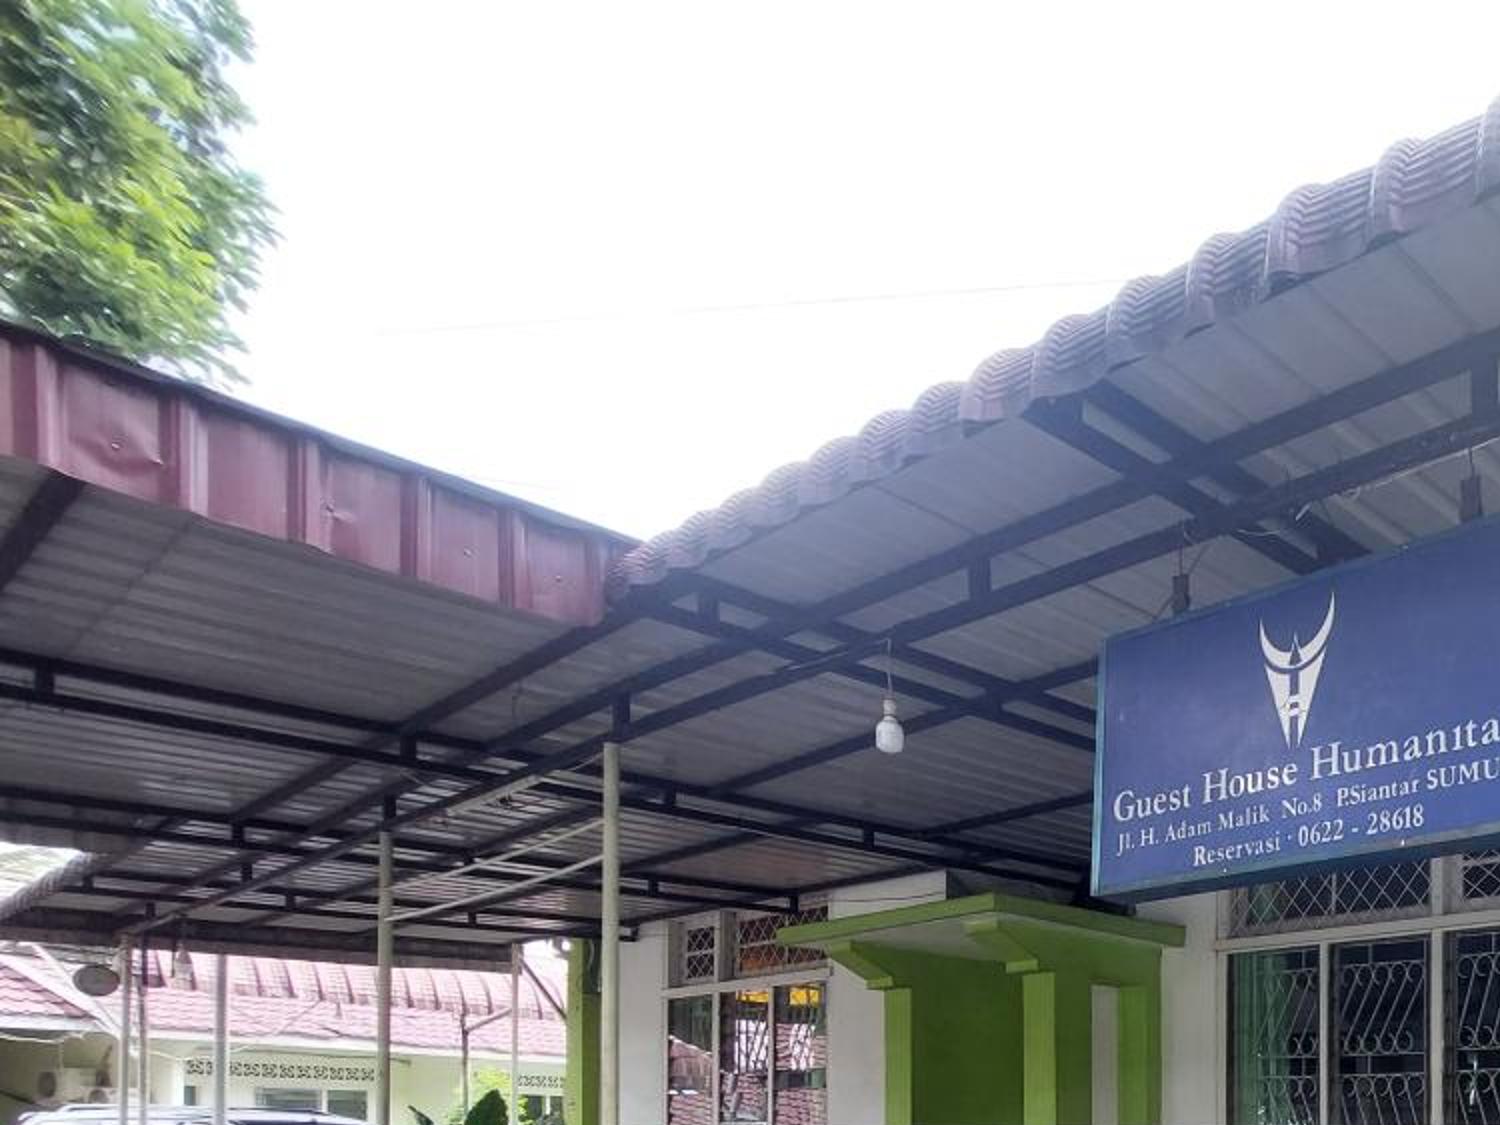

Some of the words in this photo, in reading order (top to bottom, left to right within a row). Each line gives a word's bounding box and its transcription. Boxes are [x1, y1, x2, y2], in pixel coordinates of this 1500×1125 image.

[1113, 784, 1190, 822] Guest
[1202, 762, 1298, 805] House
[1140, 826, 1160, 847] H.
[1165, 820, 1212, 842] Adam
[1218, 804, 1270, 831] Malik
[1281, 792, 1323, 819] No.8
[1193, 831, 1281, 867] Reservasi
[1297, 819, 1344, 847] 0622
[1366, 803, 1425, 835] 28618
